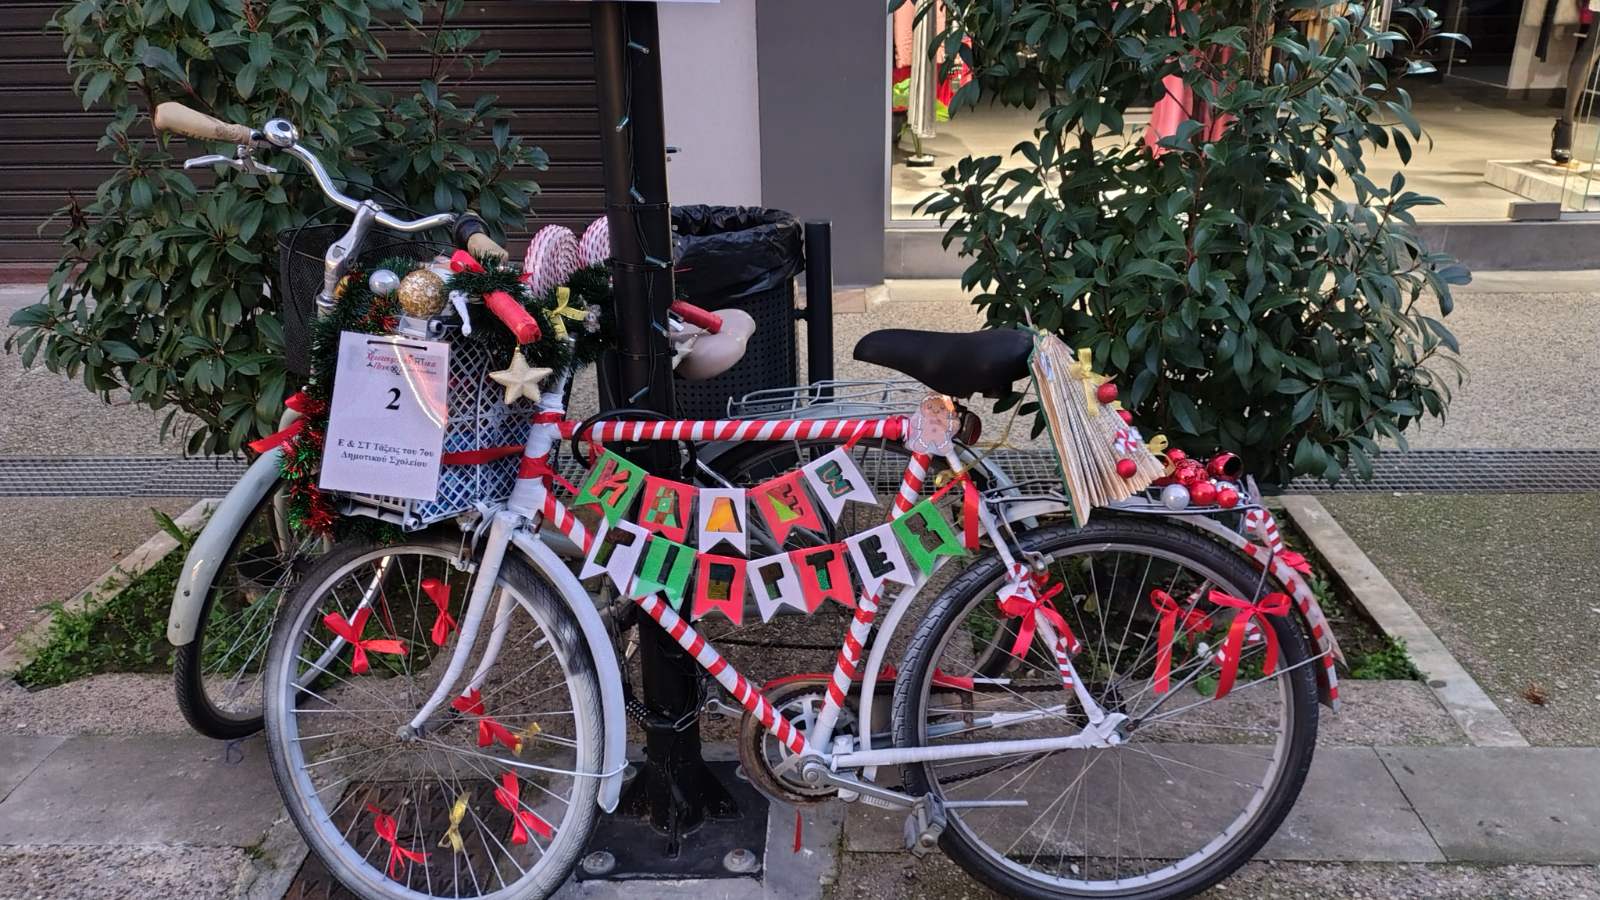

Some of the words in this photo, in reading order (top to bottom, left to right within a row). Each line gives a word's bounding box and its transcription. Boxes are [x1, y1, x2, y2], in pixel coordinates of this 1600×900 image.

[385, 387, 401, 410] 2
[340, 450, 387, 464] Δημοτικού
[389, 455, 429, 468] Σχολείου
[346, 440, 355, 448] &
[357, 441, 370, 450] ΣΤ
[373, 443, 401, 455] Τάξεις
[402, 448, 417, 456] του
[419, 448, 435, 457] 7ου
[589, 458, 856, 533] ΚΑΛΕΣ
[593, 511, 945, 601] ΓΙΟΡΤΕΣ
